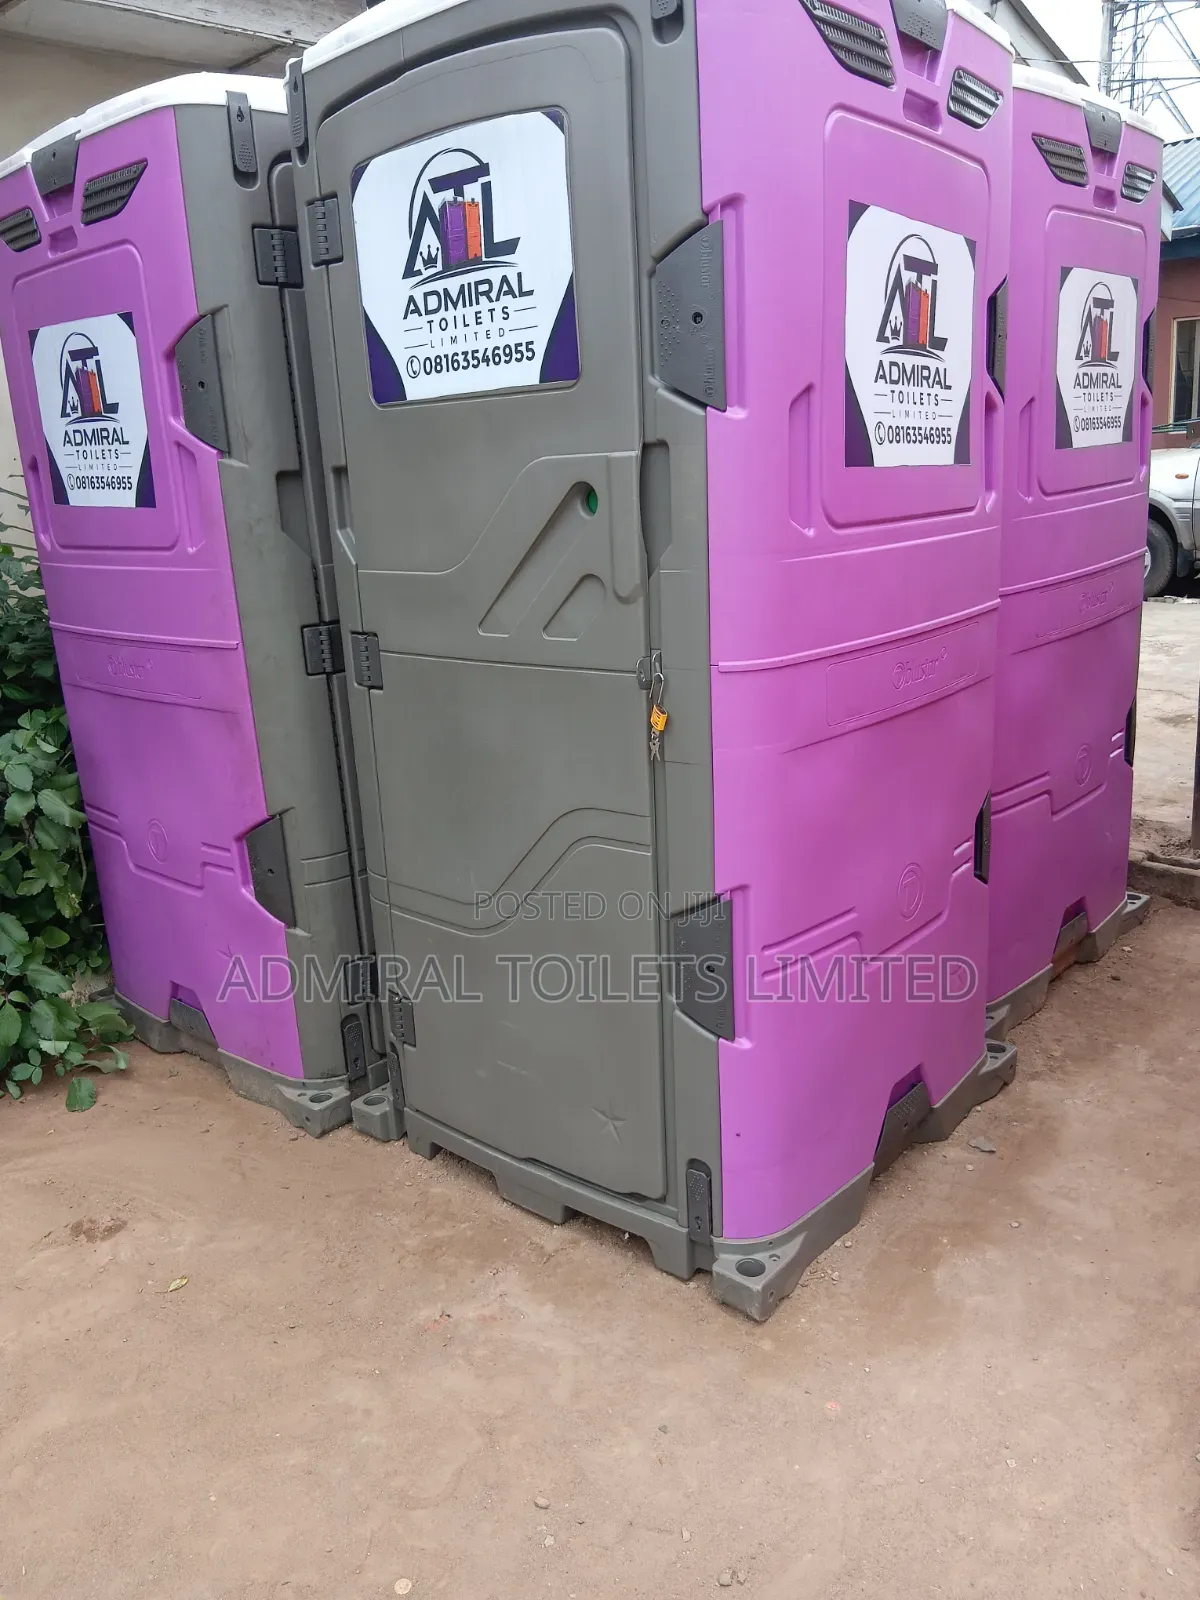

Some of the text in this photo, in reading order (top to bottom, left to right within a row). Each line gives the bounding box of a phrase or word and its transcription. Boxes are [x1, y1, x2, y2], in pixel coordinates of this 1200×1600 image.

[402, 271, 535, 321] ADMIRAL
[427, 306, 511, 333] TOILETS
[430, 327, 506, 349] LIMITED
[423, 341, 536, 376] 08163546955
[873, 359, 953, 391] ADMIRAL
[1073, 372, 1122, 390] ADMIRAL
[890, 389, 940, 407] TOILETS
[1082, 391, 1114, 402] TOILETS
[892, 409, 937, 420] LIMITED
[1080, 415, 1122, 432] 08163546955
[63, 427, 130, 447] ADMIRAL
[887, 424, 952, 445] 08163546955
[75, 448, 120, 460] TOILETS
[78, 463, 118, 471] LIMITED
[75, 475, 133, 491] 08163546955
